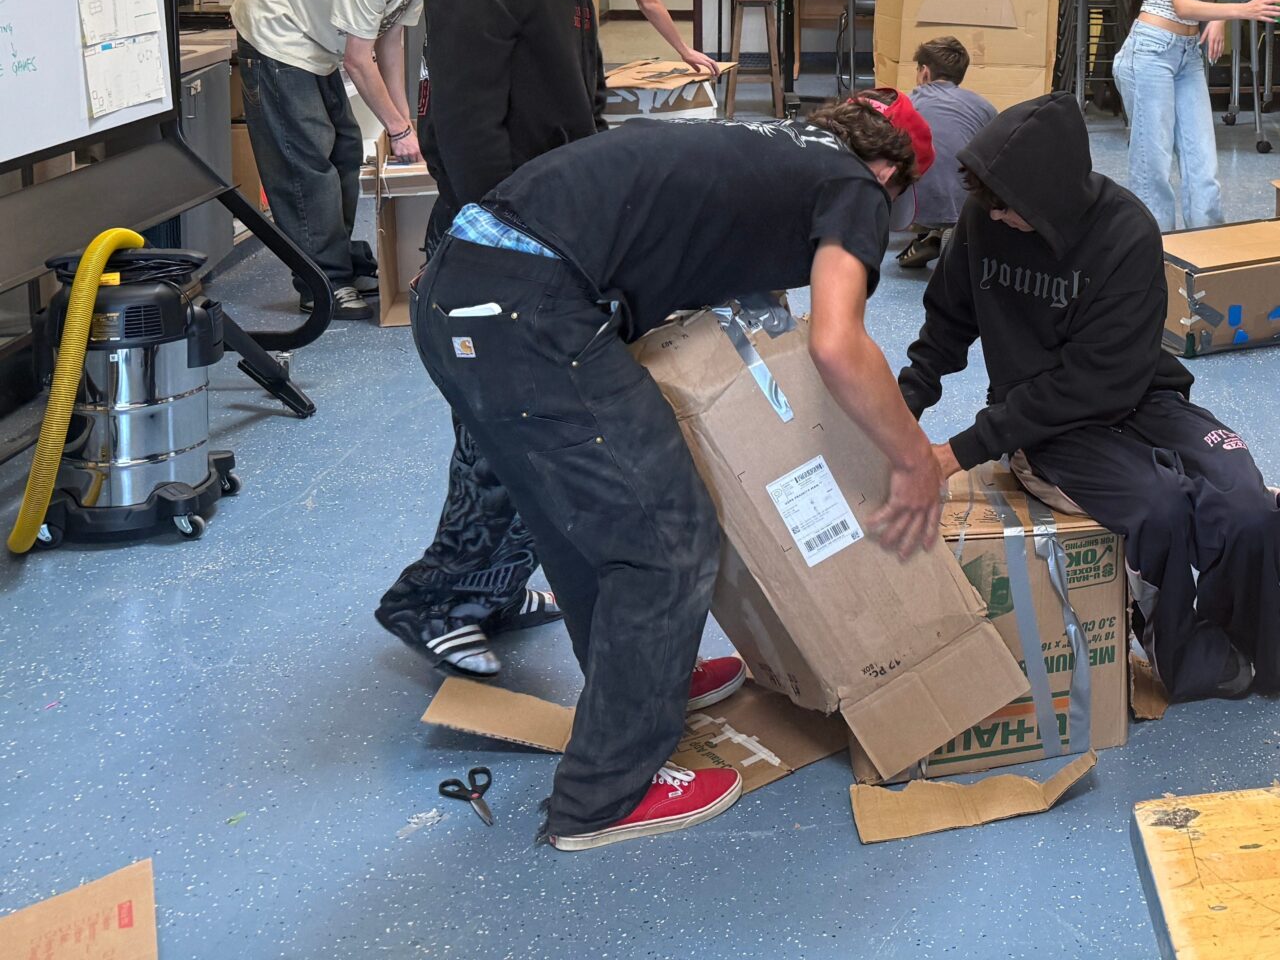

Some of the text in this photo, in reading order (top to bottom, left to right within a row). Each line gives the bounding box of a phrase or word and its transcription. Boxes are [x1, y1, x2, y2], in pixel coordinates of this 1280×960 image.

[980, 257, 1090, 308] youngl
[1065, 536, 1115, 550] FOR SHIPPING
[1066, 548, 1097, 567] OK
[1067, 571, 1101, 584] U-HAU
[1100, 616, 1117, 628] 3.0
[1105, 631, 1116, 641] 18
[861, 663, 874, 676] BOX
[889, 658, 901, 670] 17
